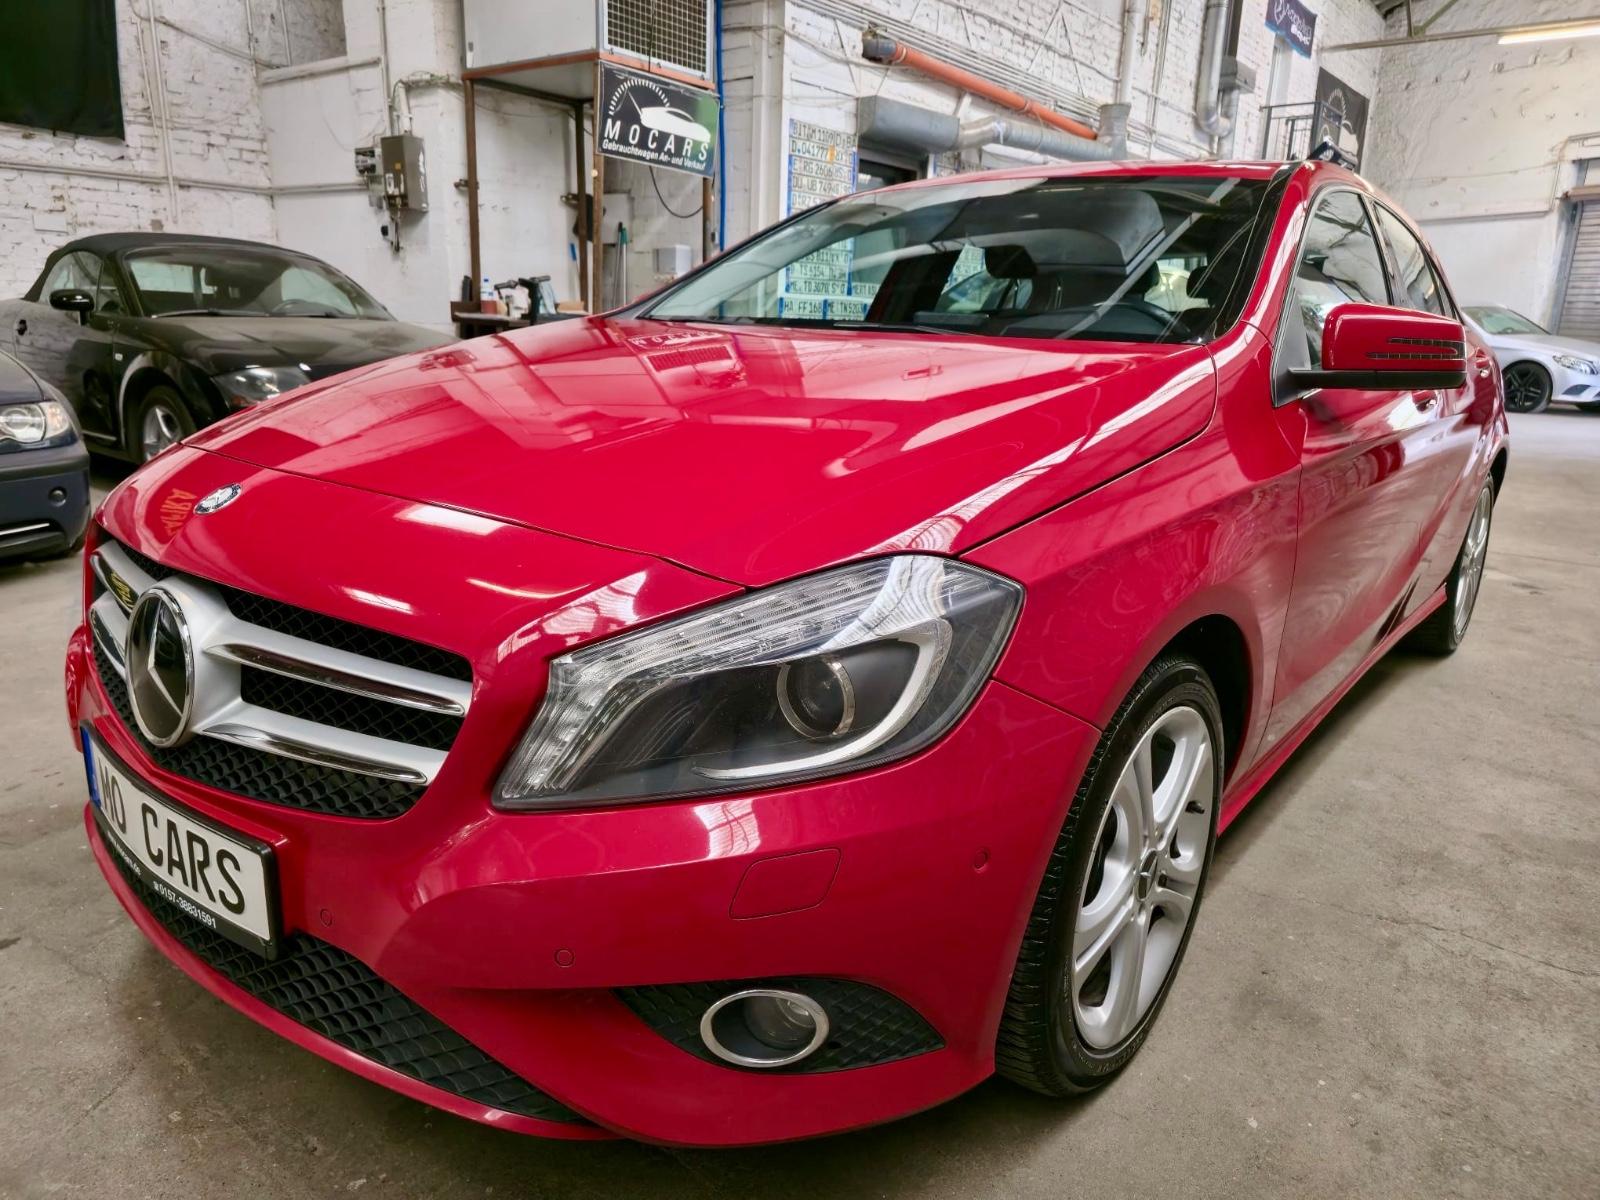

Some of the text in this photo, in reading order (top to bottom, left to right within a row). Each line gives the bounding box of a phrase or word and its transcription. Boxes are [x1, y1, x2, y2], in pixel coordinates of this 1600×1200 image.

[604, 118, 709, 161] MOCARS
[671, 156, 683, 166] und
[98, 756, 127, 835] MO
[141, 802, 246, 915] CARS
